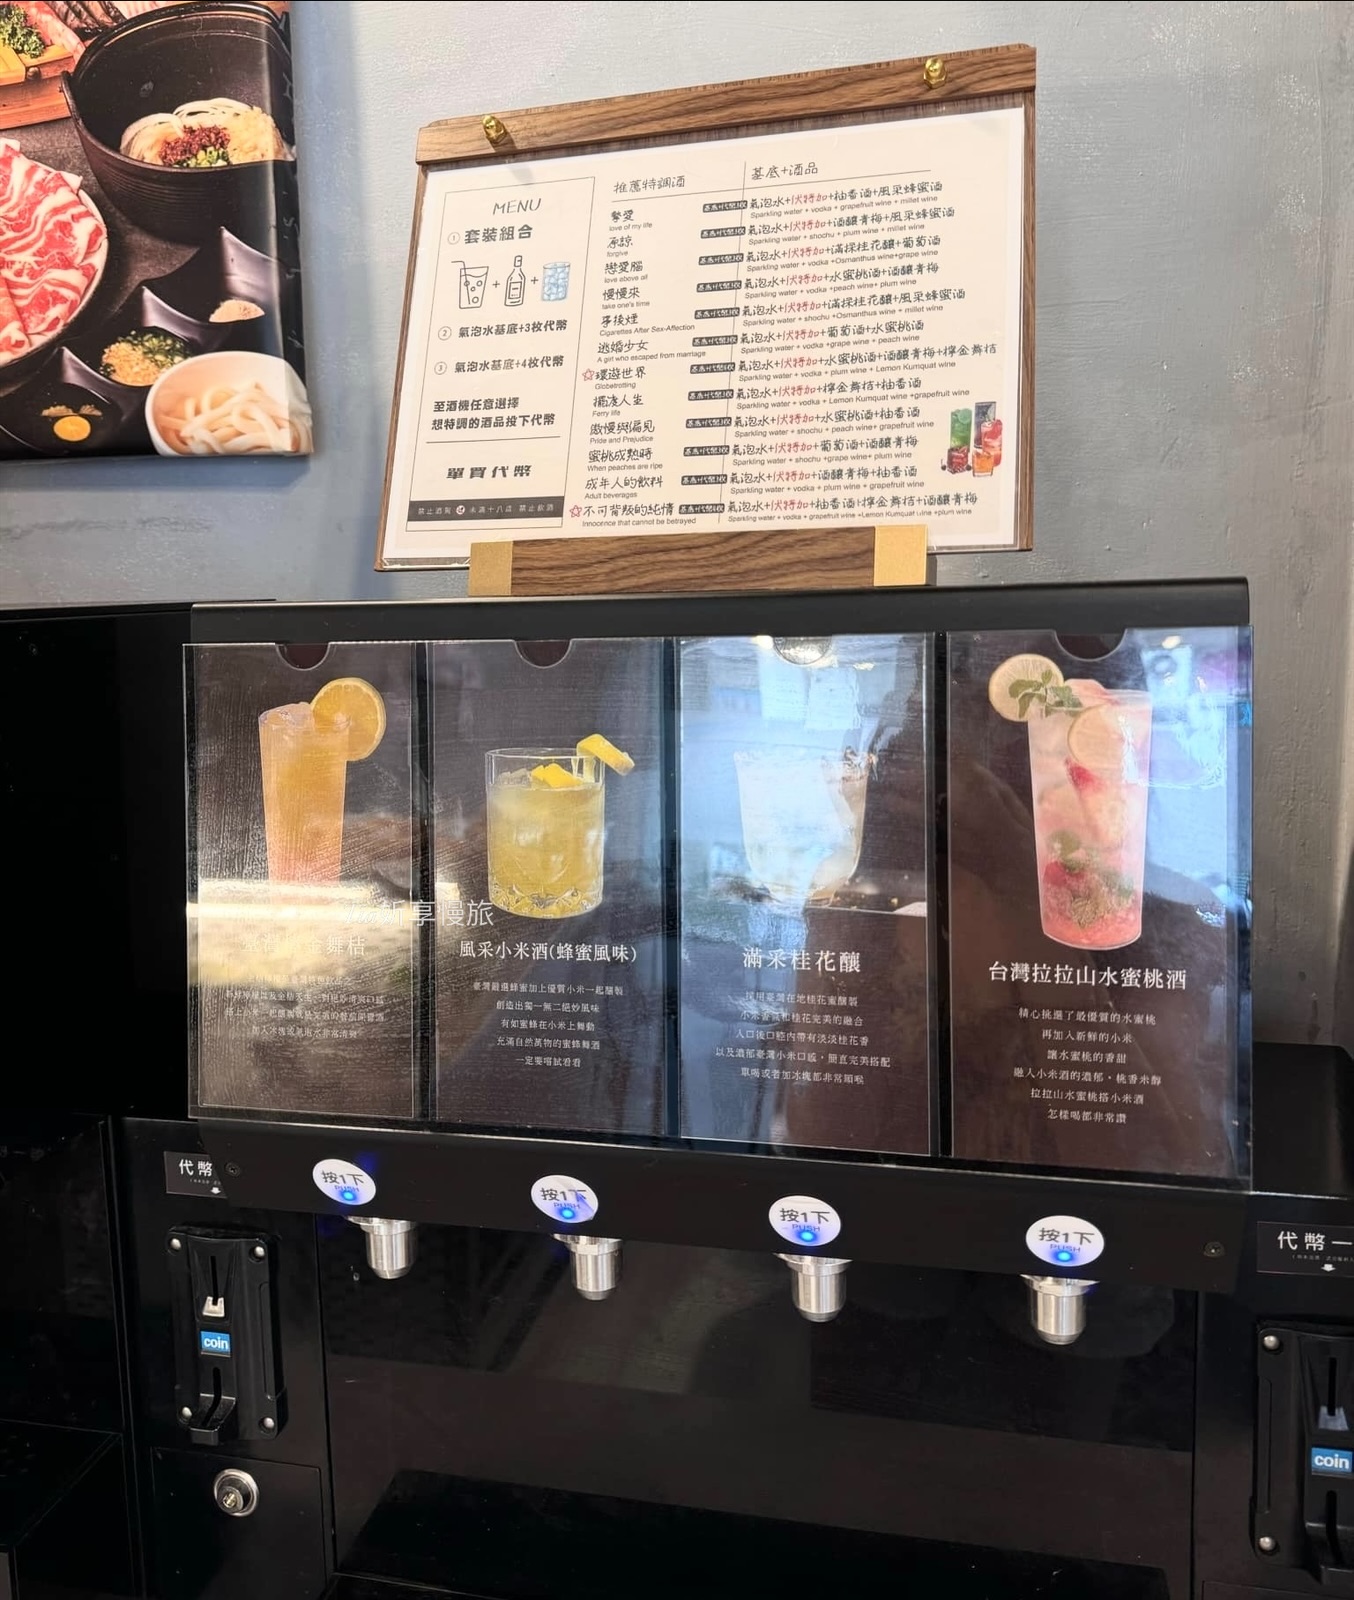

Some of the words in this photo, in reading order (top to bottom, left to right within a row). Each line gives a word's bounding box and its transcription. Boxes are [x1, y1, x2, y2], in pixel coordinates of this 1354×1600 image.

[752, 162, 818, 180] 基底+酒品
[613, 175, 685, 194] 推薦特調酒
[492, 198, 541, 215] MENU
[464, 224, 533, 244] 套裝組合
[604, 260, 643, 275] 戀愛腦
[602, 286, 640, 301] 慢慢來
[458, 320, 568, 338] 氣泡水基底+3枚代幣
[598, 340, 649, 354] 逃婚少女
[433, 396, 520, 413] 至酒機任意選擇
[431, 413, 556, 431] 想特調的酒品投下代幣
[590, 420, 655, 436] 傲慢與偏見
[588, 448, 653, 464] 蜜桃成熟時
[585, 475, 664, 490] 成年人的飲料
[459, 940, 637, 963] 風采小米酒(蜂蜜風味)
[742, 947, 861, 974] 滿采桂花釀
[988, 960, 1187, 990] 台灣拉拉山水蜜桃酒
[1018, 1006, 1157, 1026] 精心挑選了最優質的水蜜桃
[1042, 1029, 1133, 1044] 再加入新鮮的小米
[1046, 1050, 1127, 1064] 讓水蜜桃的香甜
[1030, 1088, 1144, 1106] 拉拉山水蜜桃搭小米酒
[1047, 1108, 1127, 1125] 怎樣喝都非常讚
[178, 1158, 212, 1176] 代幣
[320, 1169, 364, 1186] 按1下
[540, 1187, 587, 1202] 按1下
[553, 1202, 581, 1210] PUSH
[780, 1208, 830, 1224] 按1下
[792, 1223, 820, 1232] PUSH
[1038, 1227, 1095, 1246] 按1下
[1050, 1244, 1081, 1253] PUSH
[204, 1336, 228, 1350] coin
[1314, 1454, 1350, 1470] coin
